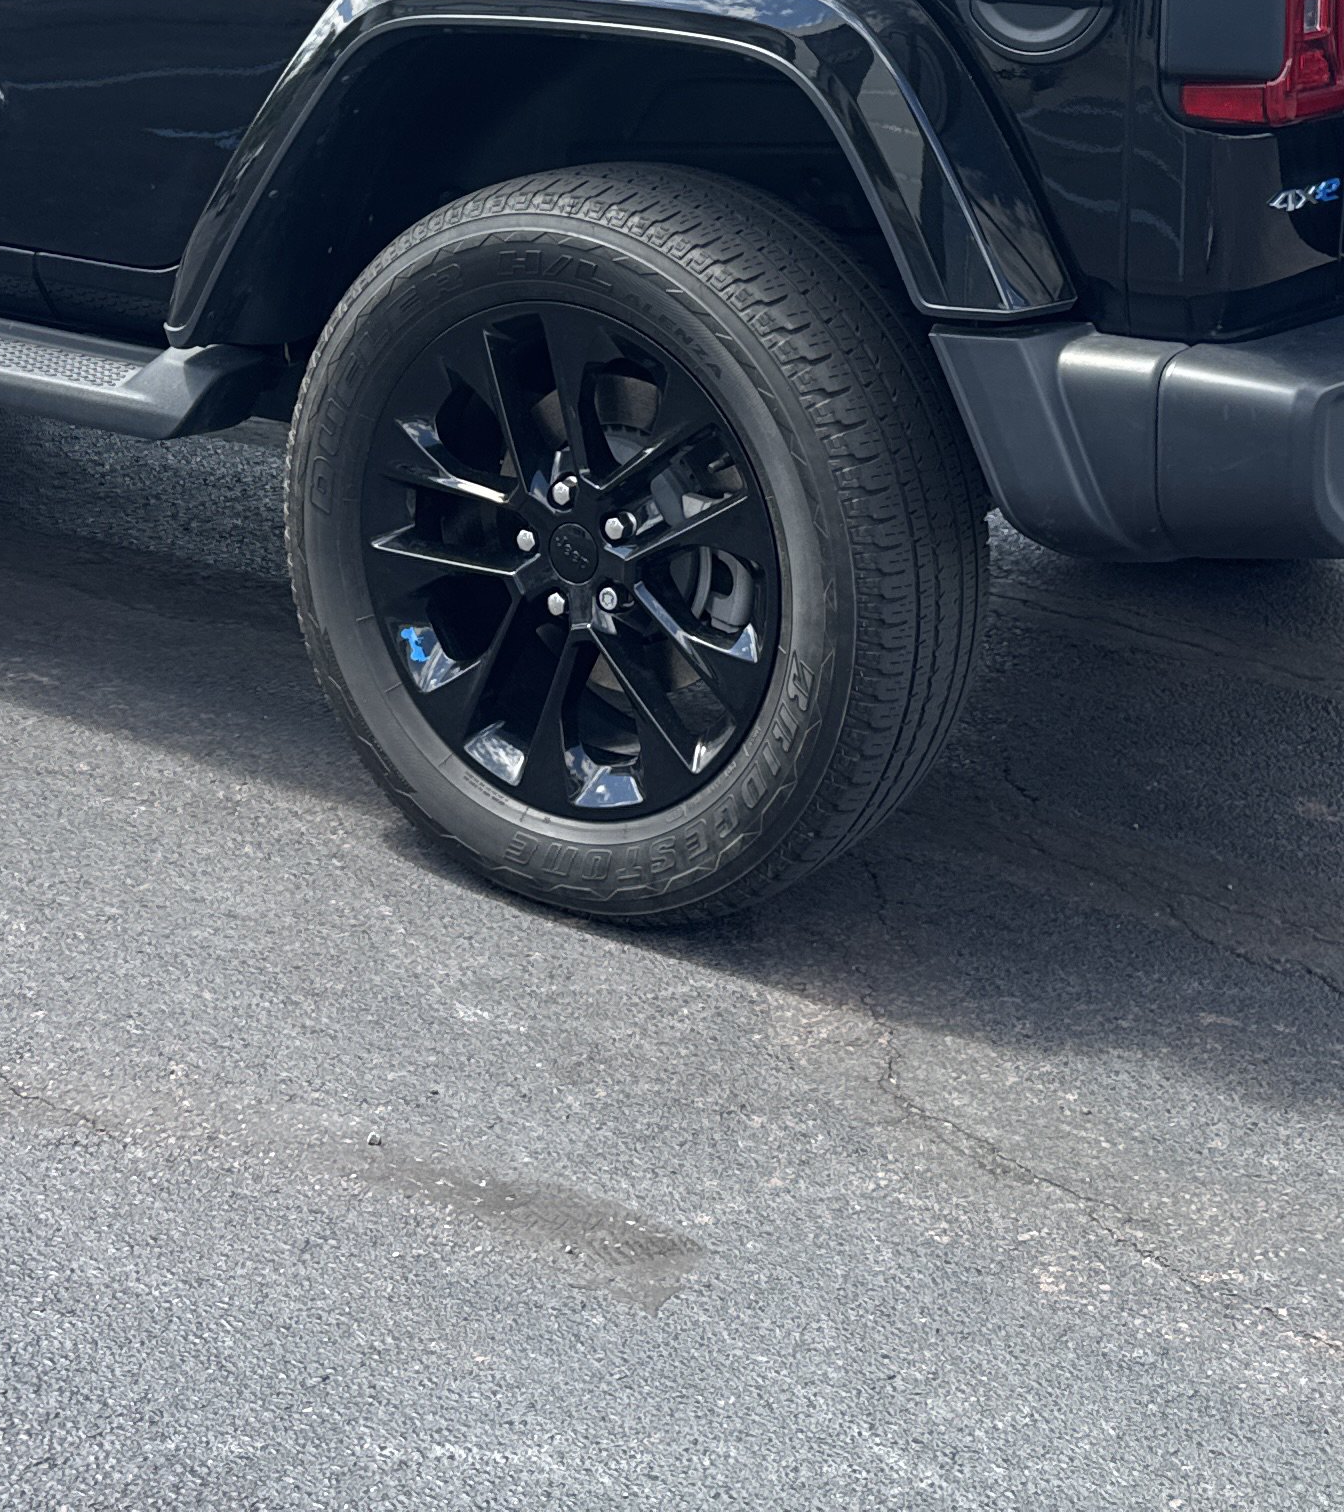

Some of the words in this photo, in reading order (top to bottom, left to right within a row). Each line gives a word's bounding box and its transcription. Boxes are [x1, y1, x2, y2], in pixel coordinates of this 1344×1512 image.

[311, 262, 463, 516] DUELER
[496, 248, 613, 288] H/L
[623, 293, 724, 381] ALENZA
[504, 651, 815, 881] BRIDGESTONE
